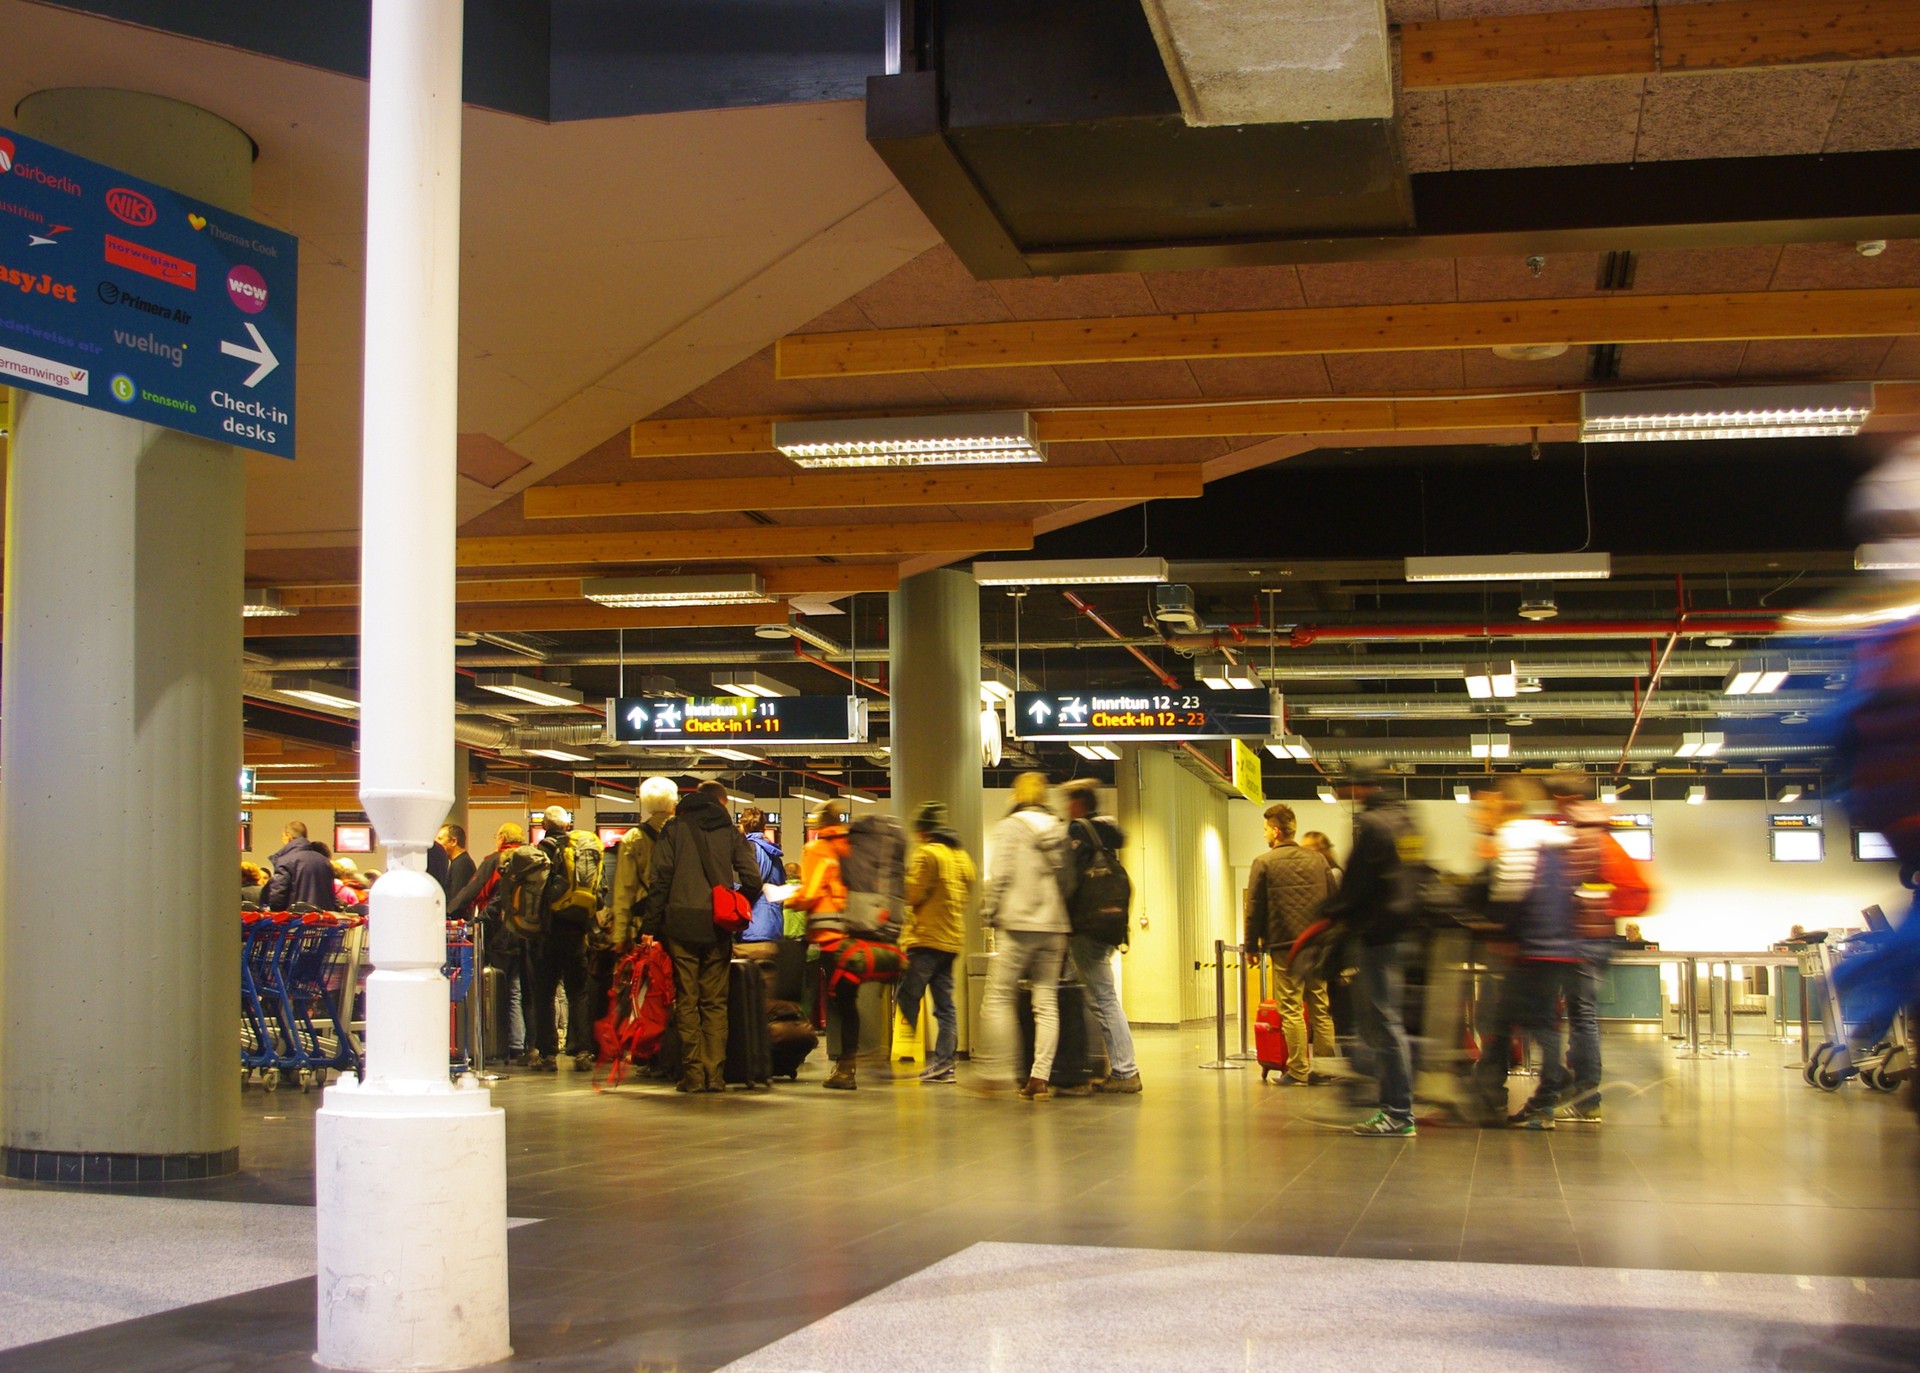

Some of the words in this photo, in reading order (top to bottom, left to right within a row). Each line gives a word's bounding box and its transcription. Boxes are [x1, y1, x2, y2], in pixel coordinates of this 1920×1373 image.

[13, 163, 82, 196] airberlin
[0, 200, 44, 224] ustrian
[109, 193, 152, 221] NIKI
[209, 223, 250, 248] Thomas
[252, 240, 278, 257] Cook
[108, 241, 178, 270] norwegian
[0, 265, 77, 303] asyJet
[121, 291, 172, 319] Primera
[173, 308, 192, 325] Air
[114, 329, 183, 368] vueling
[0, 358, 70, 386] ermanwings
[142, 389, 197, 414] transavia
[210, 390, 288, 425] Check-in
[223, 416, 276, 444] desks
[741, 703, 748, 716] 1
[760, 702, 775, 716] 11
[1092, 696, 1149, 710] Innritun
[1152, 696, 1170, 710] 12
[1182, 696, 1200, 709] 23
[685, 718, 743, 732] Check-in
[745, 719, 752, 732] 1
[764, 719, 780, 732] 11
[1092, 712, 1155, 727] Check-in
[1157, 712, 1176, 727] 12
[1187, 712, 1205, 726] 23
[839, 813, 846, 822] 9
[1806, 815, 1818, 825] 14
